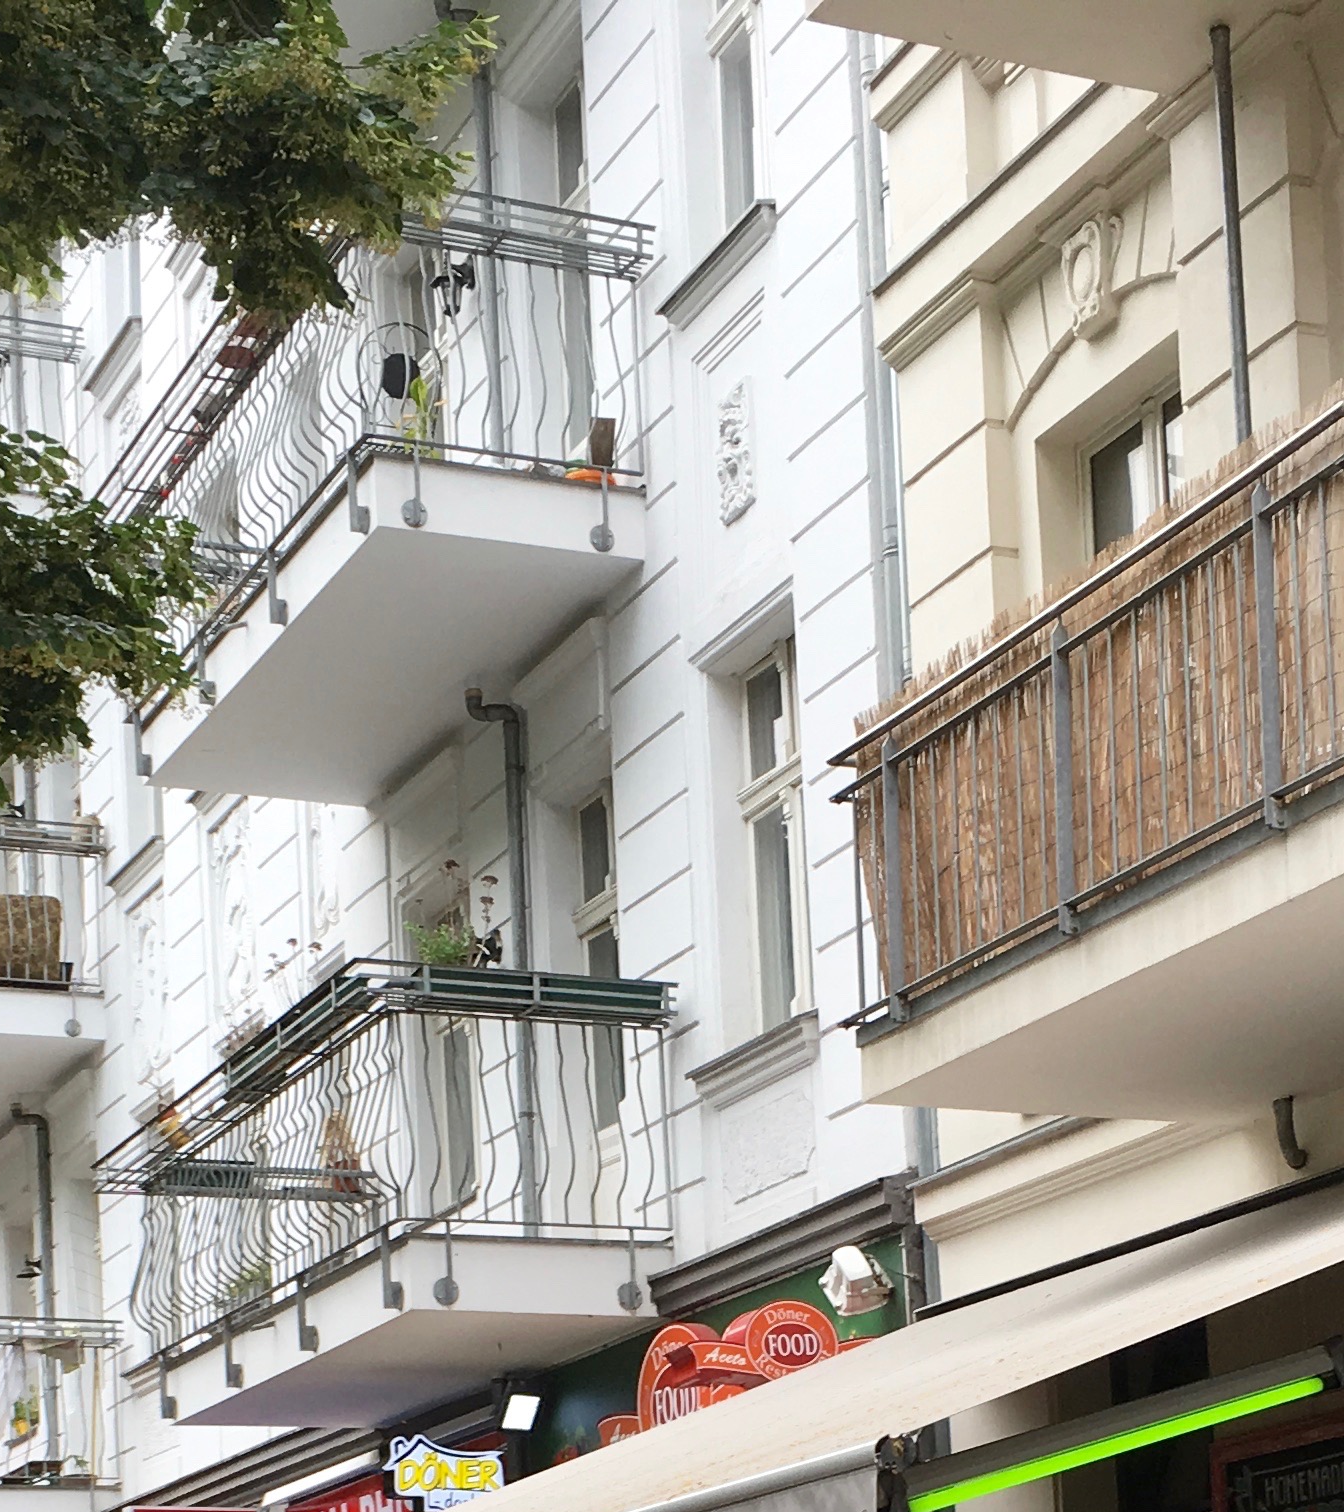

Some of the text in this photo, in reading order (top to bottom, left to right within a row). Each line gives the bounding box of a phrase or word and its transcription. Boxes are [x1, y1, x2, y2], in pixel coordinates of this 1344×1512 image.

[763, 1309, 811, 1324] Döner
[767, 1333, 817, 1357] FOOD
[398, 1452, 501, 1492] DÖNER
